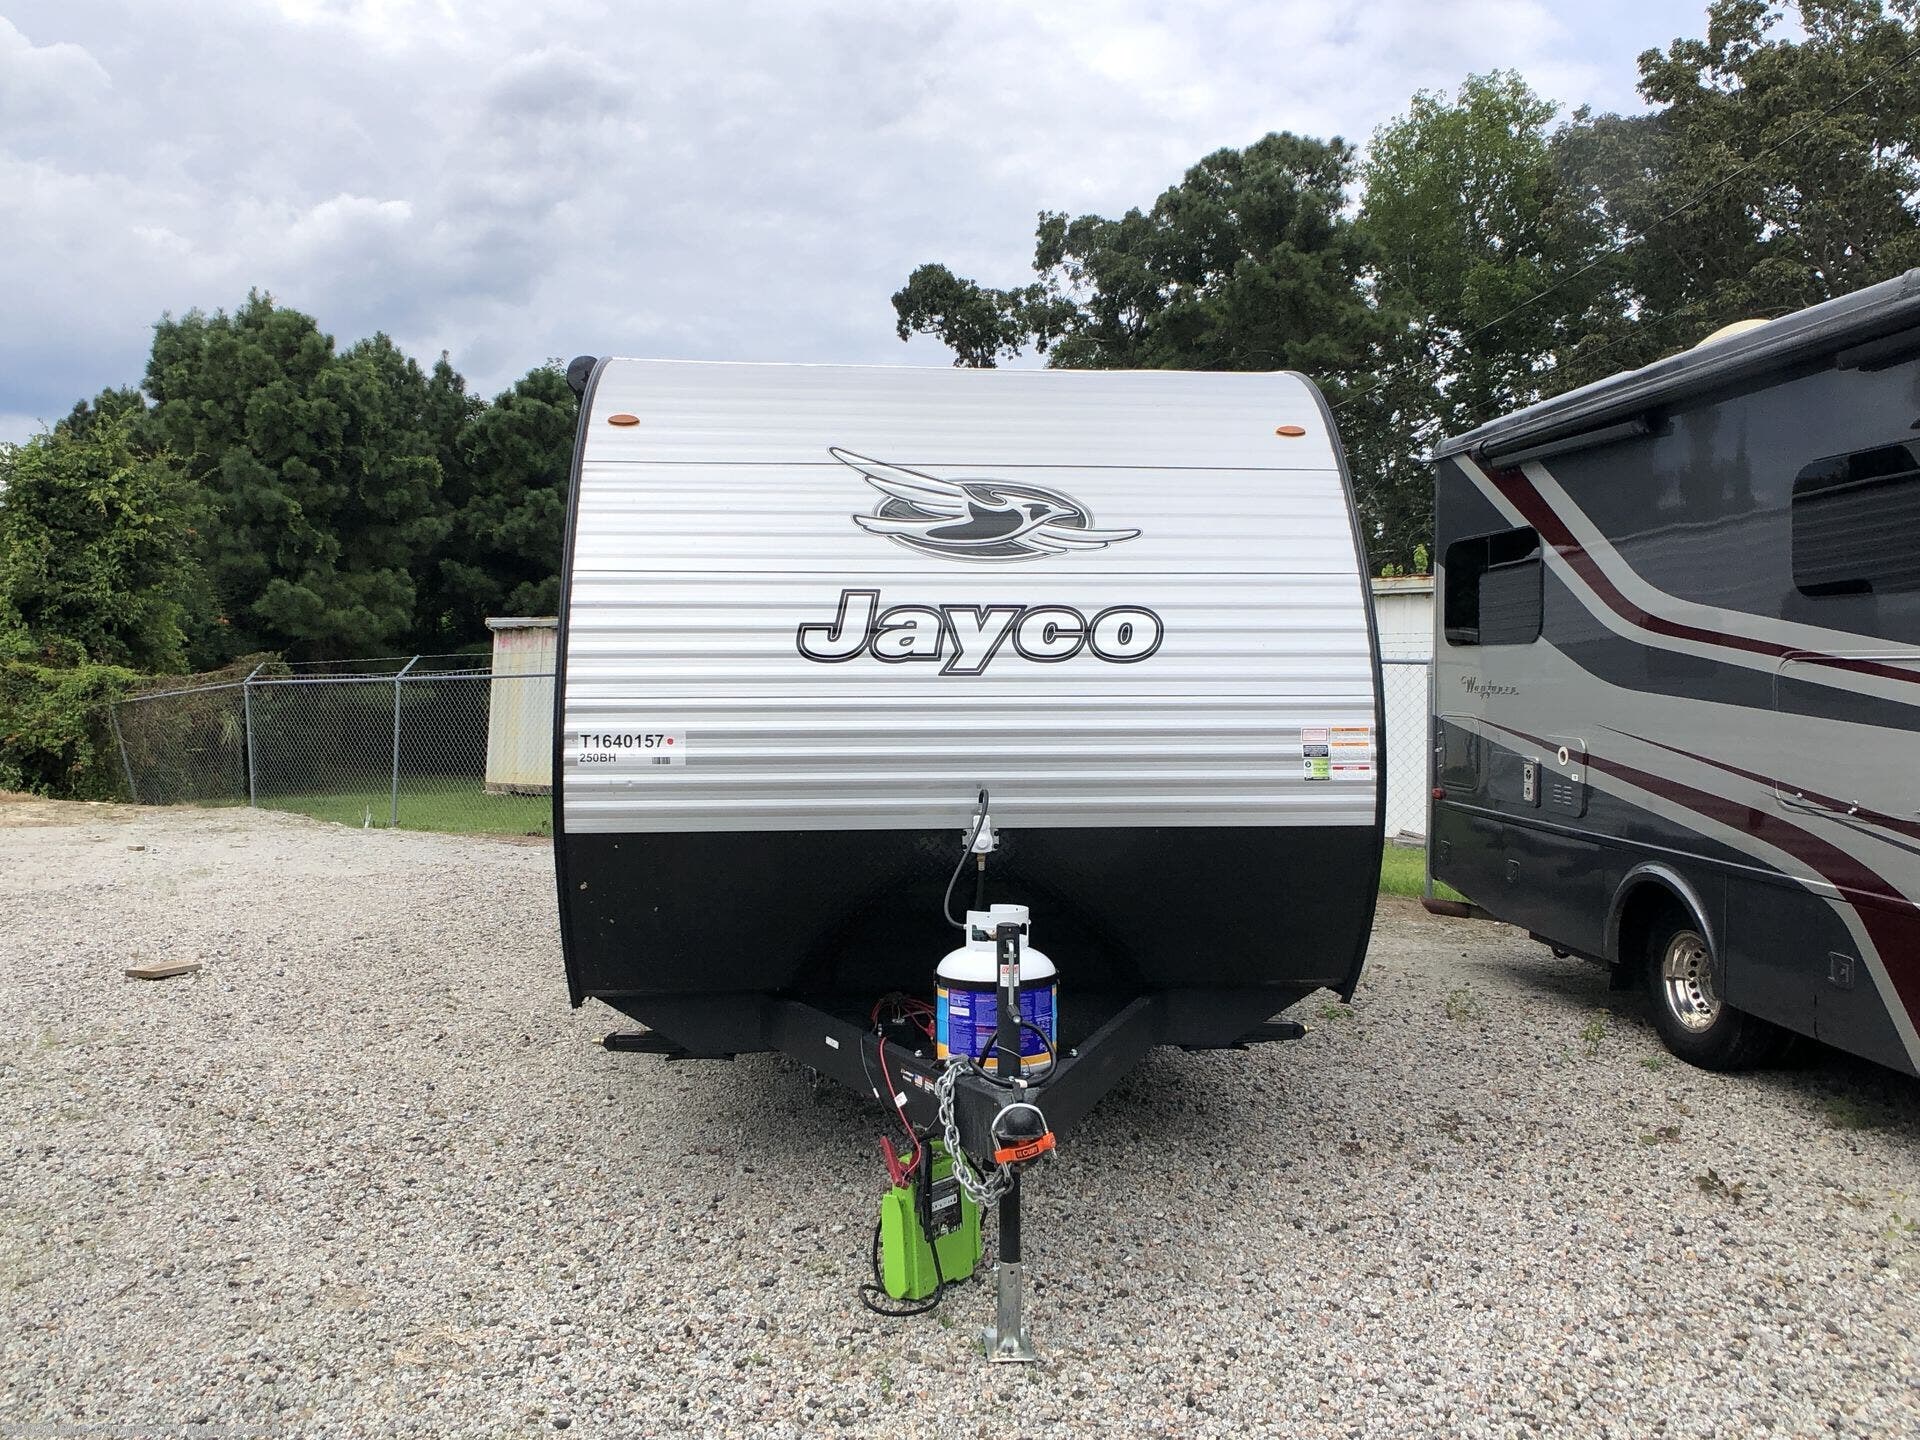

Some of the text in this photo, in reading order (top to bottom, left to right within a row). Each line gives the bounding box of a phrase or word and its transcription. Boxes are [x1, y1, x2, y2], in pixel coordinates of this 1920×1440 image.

[796, 589, 1164, 676] Jayco
[580, 734, 664, 749] T1640157
[579, 753, 617, 763] 250BH
